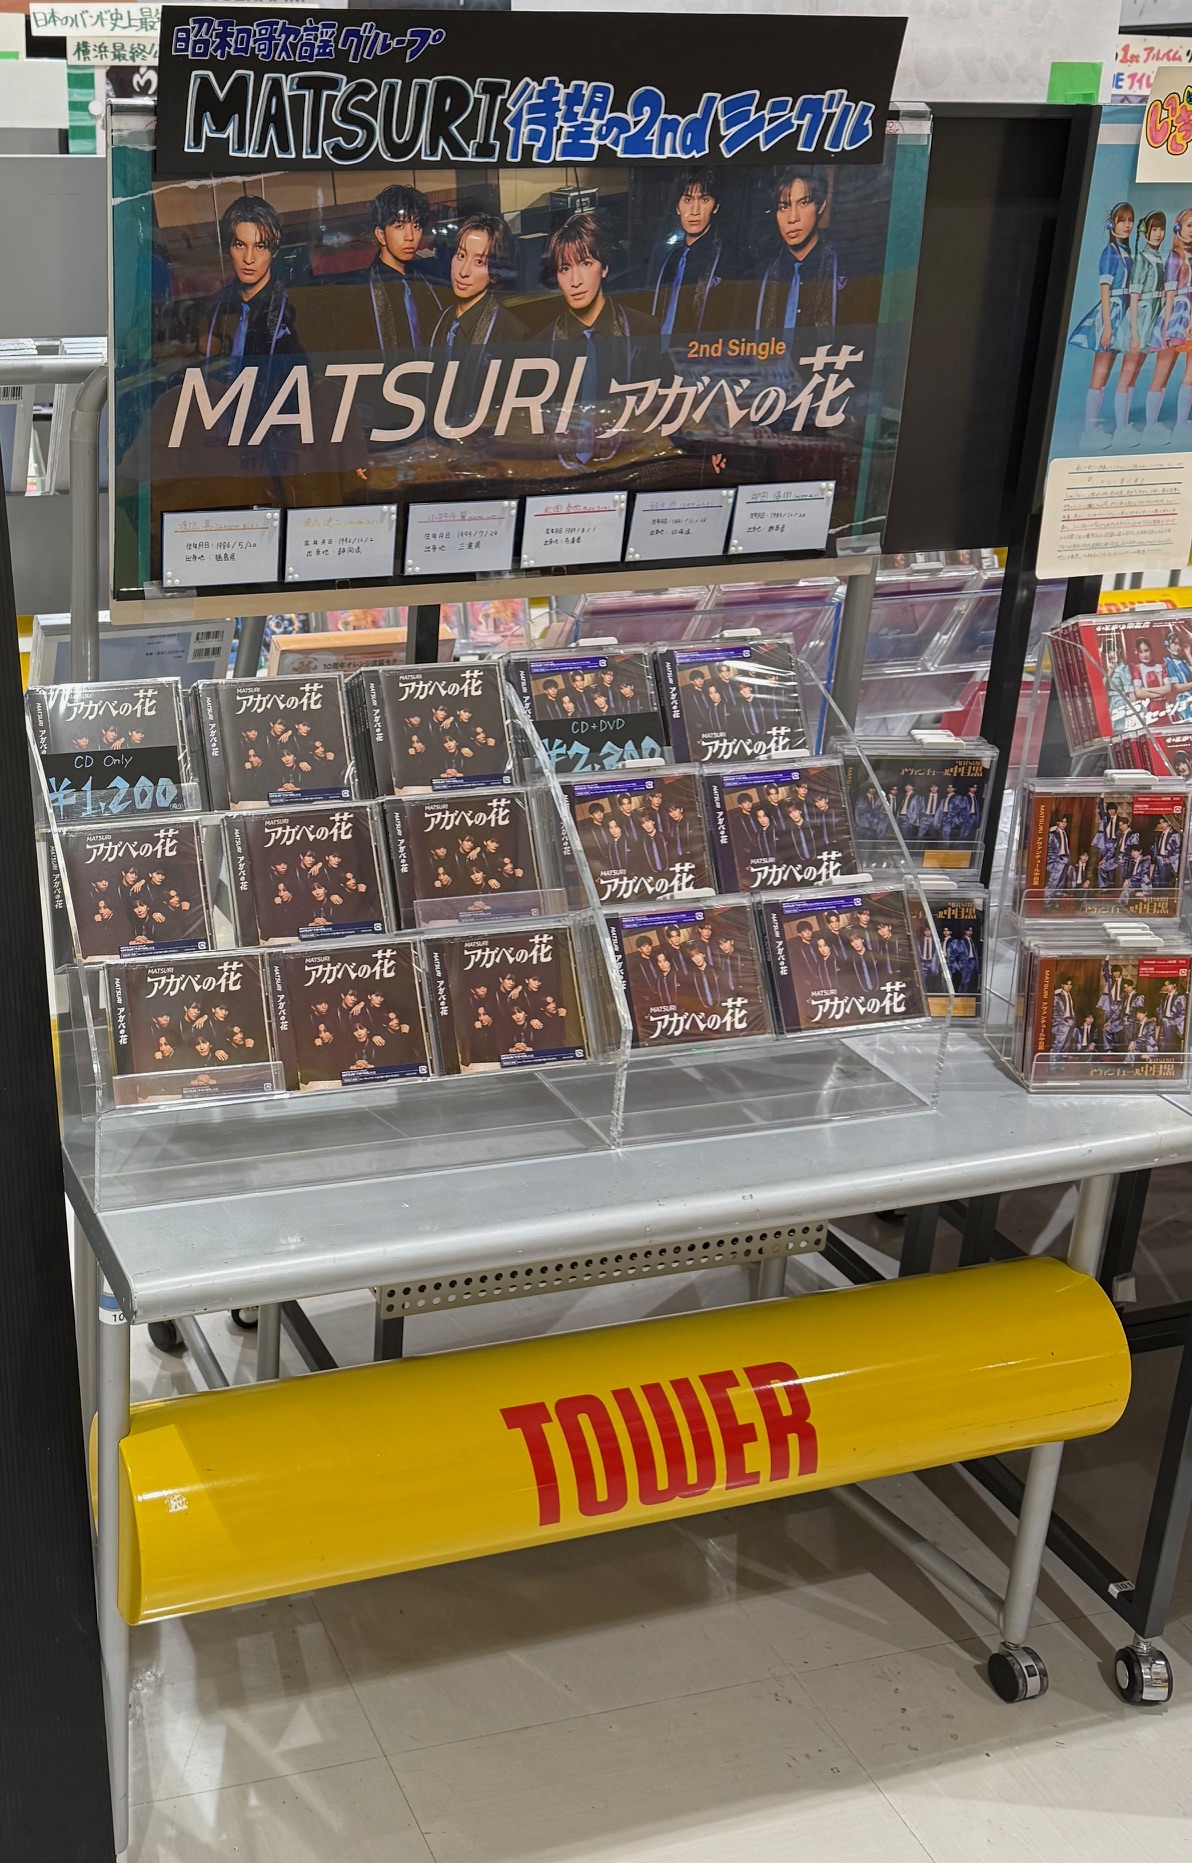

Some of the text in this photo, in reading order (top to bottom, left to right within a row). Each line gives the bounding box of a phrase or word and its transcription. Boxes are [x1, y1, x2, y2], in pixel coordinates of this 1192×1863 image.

[172, 17, 446, 63] 昭和歌謡グループ
[184, 70, 512, 165] MATSURI
[688, 338, 786, 360] 2nd Single
[168, 344, 864, 448] MATSURI アガベの花
[235, 683, 323, 715] アガベの花
[398, 670, 483, 701] アガベの花
[66, 689, 158, 721] アガベの花
[74, 754, 133, 769] CD Only
[701, 726, 791, 761] アガベの花
[264, 812, 353, 848] アガベの花
[424, 798, 510, 832] アガベの花
[85, 828, 179, 864] アガベの花
[87, 834, 112, 842] MATSURI
[600, 869, 627, 877] MATSURI
[600, 862, 695, 901] アガベの花
[750, 851, 842, 888] アガベの花
[463, 934, 553, 971] アガベの花
[464, 940, 488, 948] MATSURI
[145, 961, 243, 998] アガベの花
[304, 949, 397, 987] アガベの花
[650, 1005, 677, 1013] MATSURI
[811, 989, 837, 997] MATSURI
[811, 981, 906, 1022] アガベの花
[649, 997, 748, 1039] アガベの花
[499, 1361, 818, 1527] TOWER
